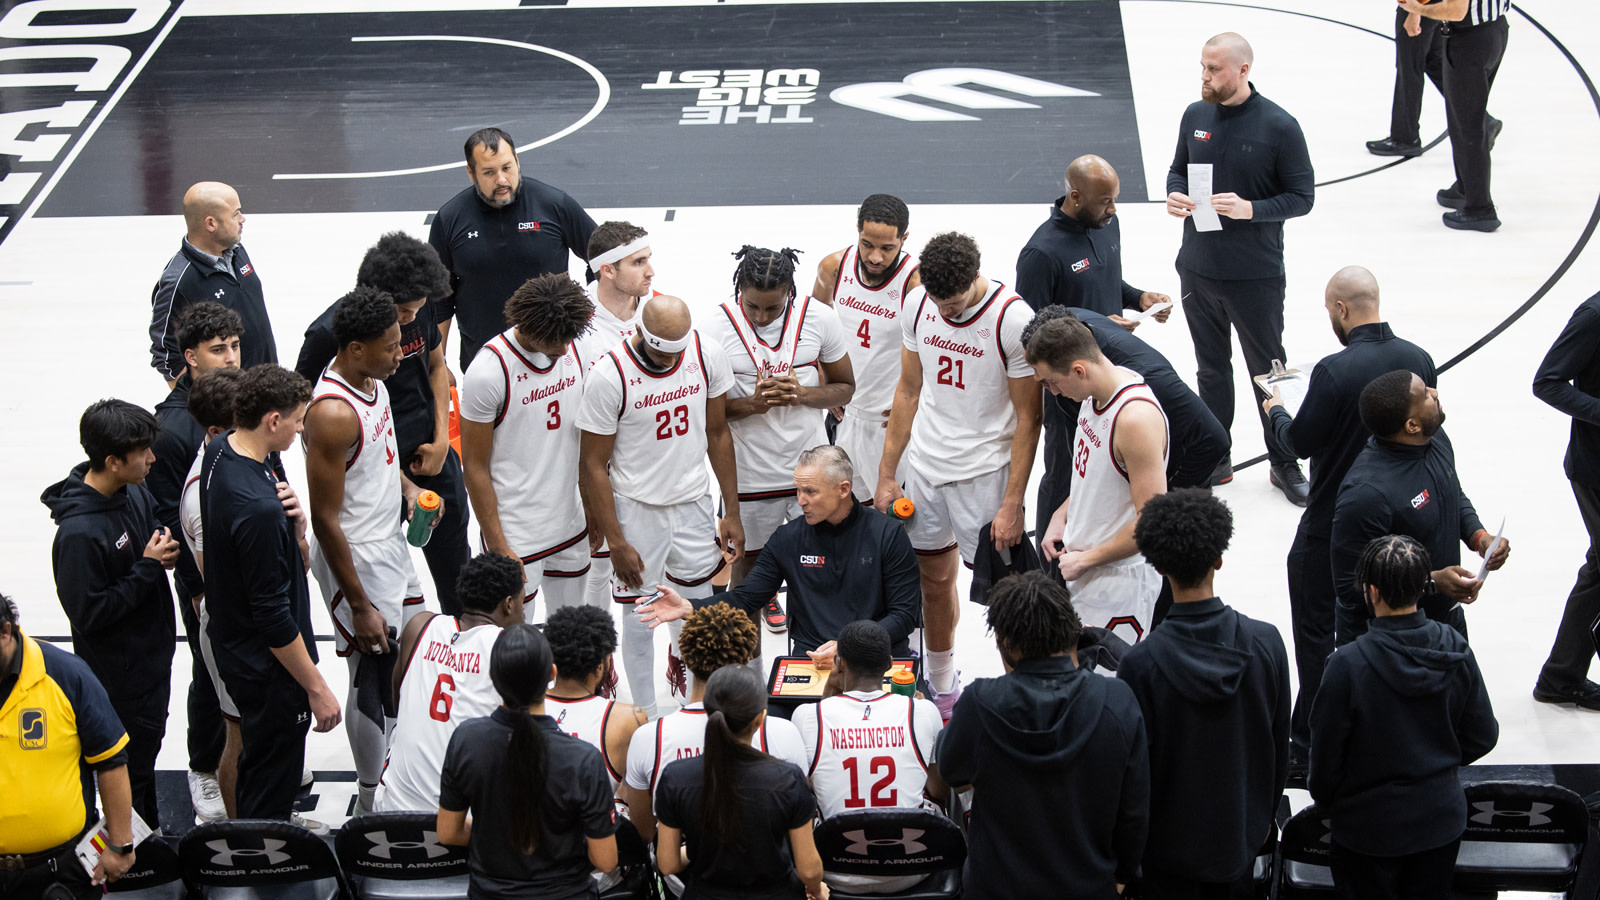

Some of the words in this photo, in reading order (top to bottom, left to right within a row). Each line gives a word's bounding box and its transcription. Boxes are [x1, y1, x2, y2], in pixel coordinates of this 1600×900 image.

[641, 68, 820, 89] WEST
[696, 87, 817, 106] BIG
[679, 105, 814, 125] THE
[518, 222, 540, 230] CSUN
[1071, 258, 1090, 272] CSUN
[839, 295, 897, 320] Matadors
[857, 319, 871, 349] 4
[923, 335, 985, 359] Matadors
[937, 355, 965, 390] 21
[522, 375, 576, 405] Matadors
[634, 383, 701, 410] Matadors
[546, 400, 561, 430] 3
[656, 404, 689, 440] 23
[1075, 438, 1090, 479] 33
[1411, 489, 1430, 508] CSUN
[115, 531, 129, 550] CSU
[800, 555, 825, 564] CSUN
[429, 673, 456, 722] 6
[830, 726, 905, 750] WASHINGTON
[842, 756, 898, 808] 12
[200, 868, 246, 876] UNDER
[250, 864, 310, 875] ARMOUR
[357, 859, 402, 868] UNDER
[406, 858, 466, 869] ARMOUR
[883, 855, 944, 864] ARMOUR
